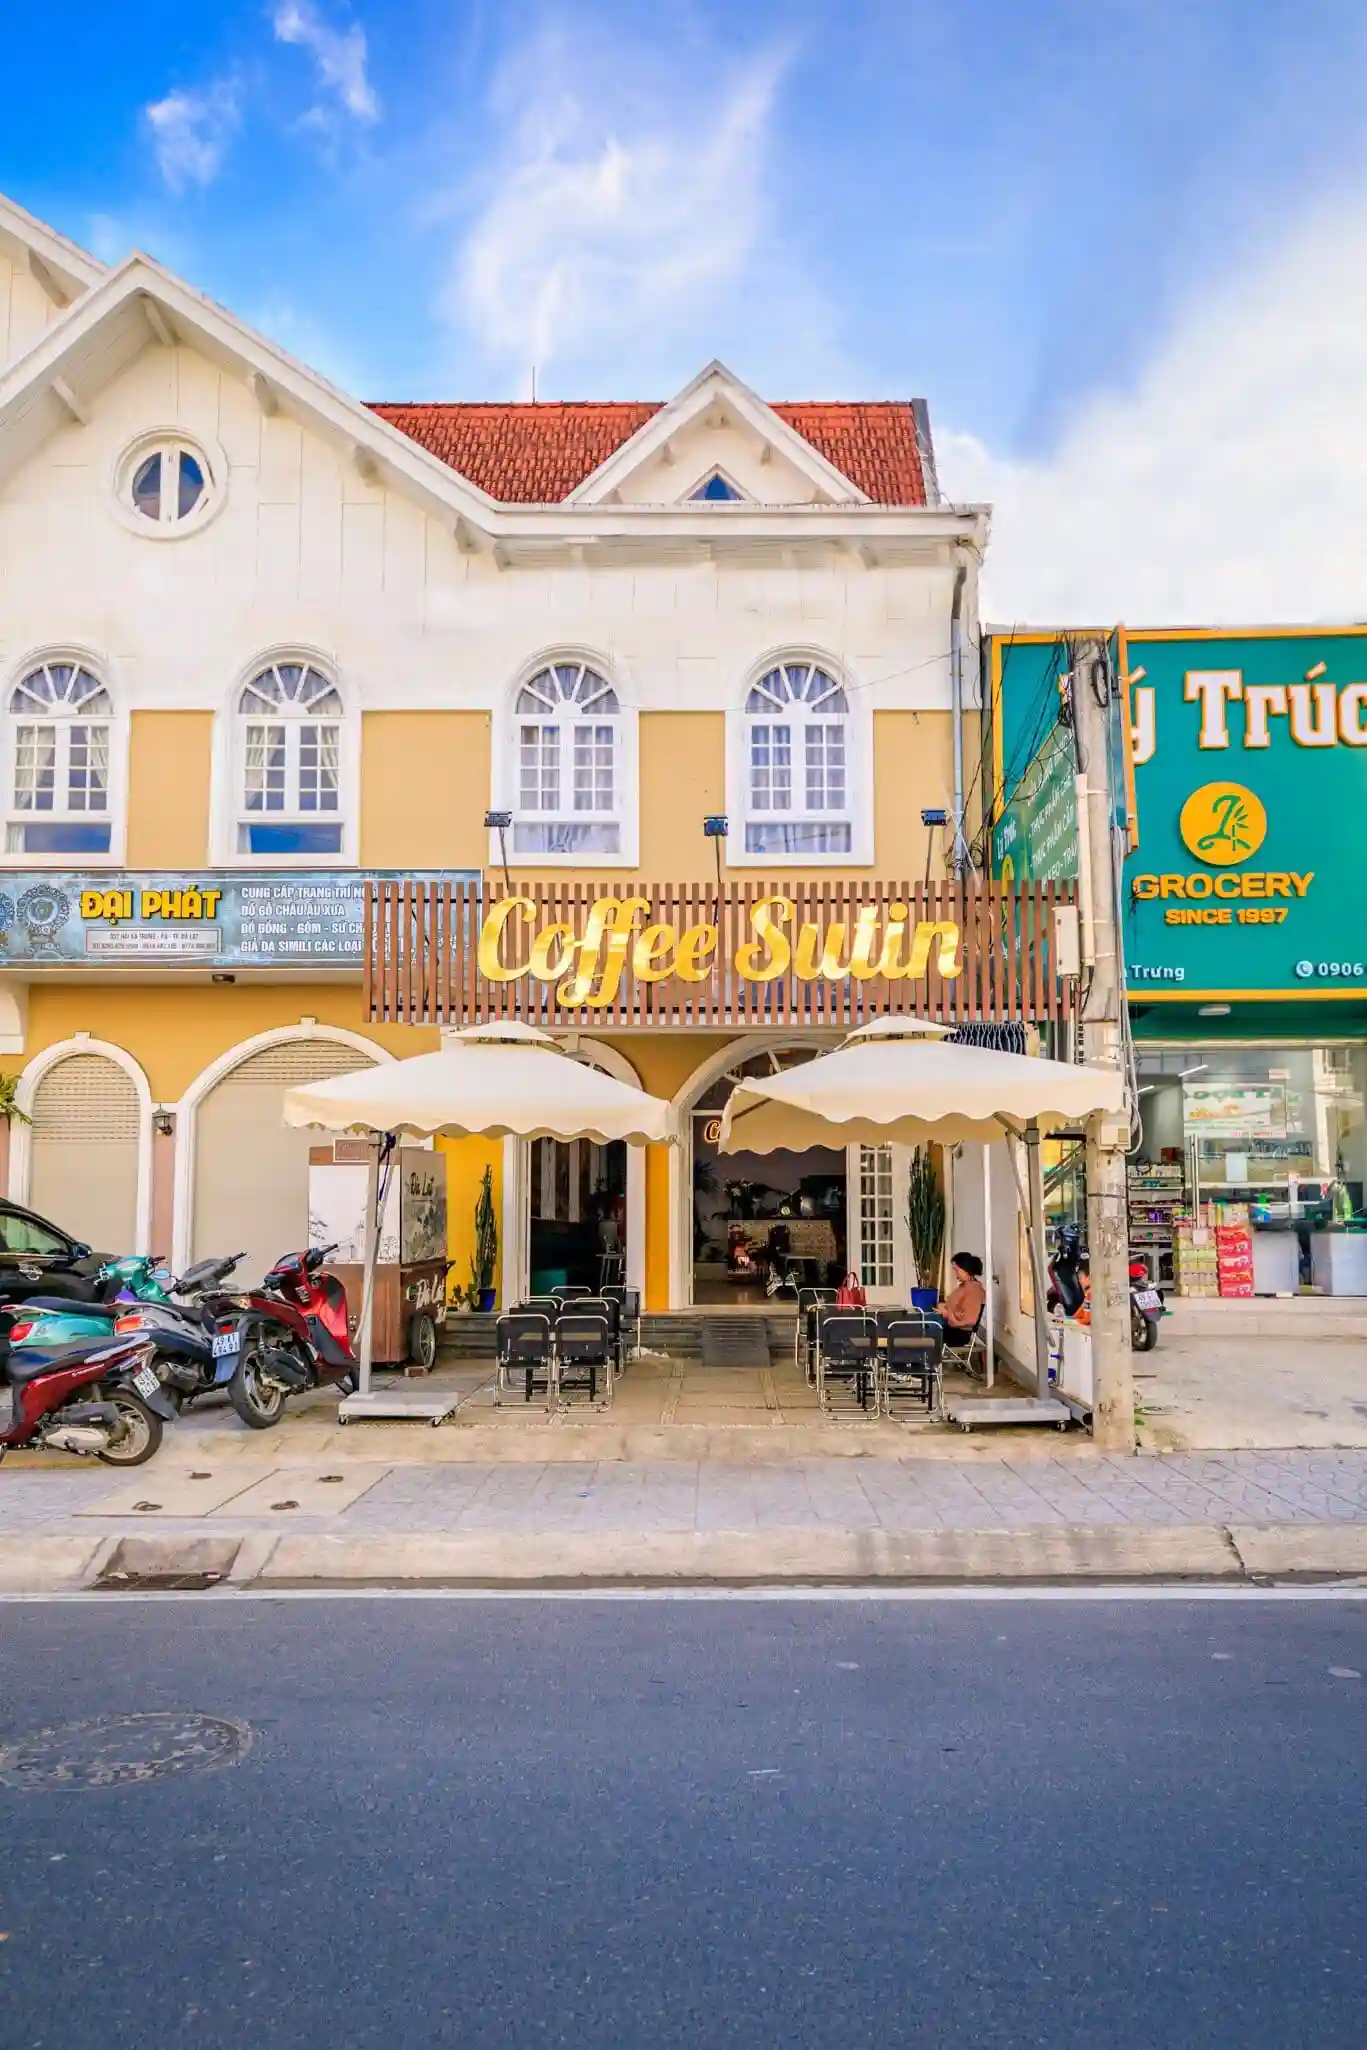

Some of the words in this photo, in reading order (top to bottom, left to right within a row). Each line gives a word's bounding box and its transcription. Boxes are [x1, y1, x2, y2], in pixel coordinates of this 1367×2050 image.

[241, 887, 271, 898] CUNG
[273, 883, 295, 898] CẤP
[297, 887, 332, 898] TRANG
[1132, 871, 1315, 900] GROCERY
[80, 889, 134, 925] ĐẠI
[141, 884, 221, 919] PHÁT
[322, 903, 346, 916] XƯA
[1164, 908, 1233, 925] SINCE
[1236, 907, 1289, 924] 1997
[261, 940, 275, 952] DA
[278, 940, 312, 952] SIMILI
[478, 896, 718, 1007] Coffee
[734, 896, 963, 980] Sutin
[1131, 964, 1185, 981] Trưng
[1318, 962, 1364, 976] 0906
